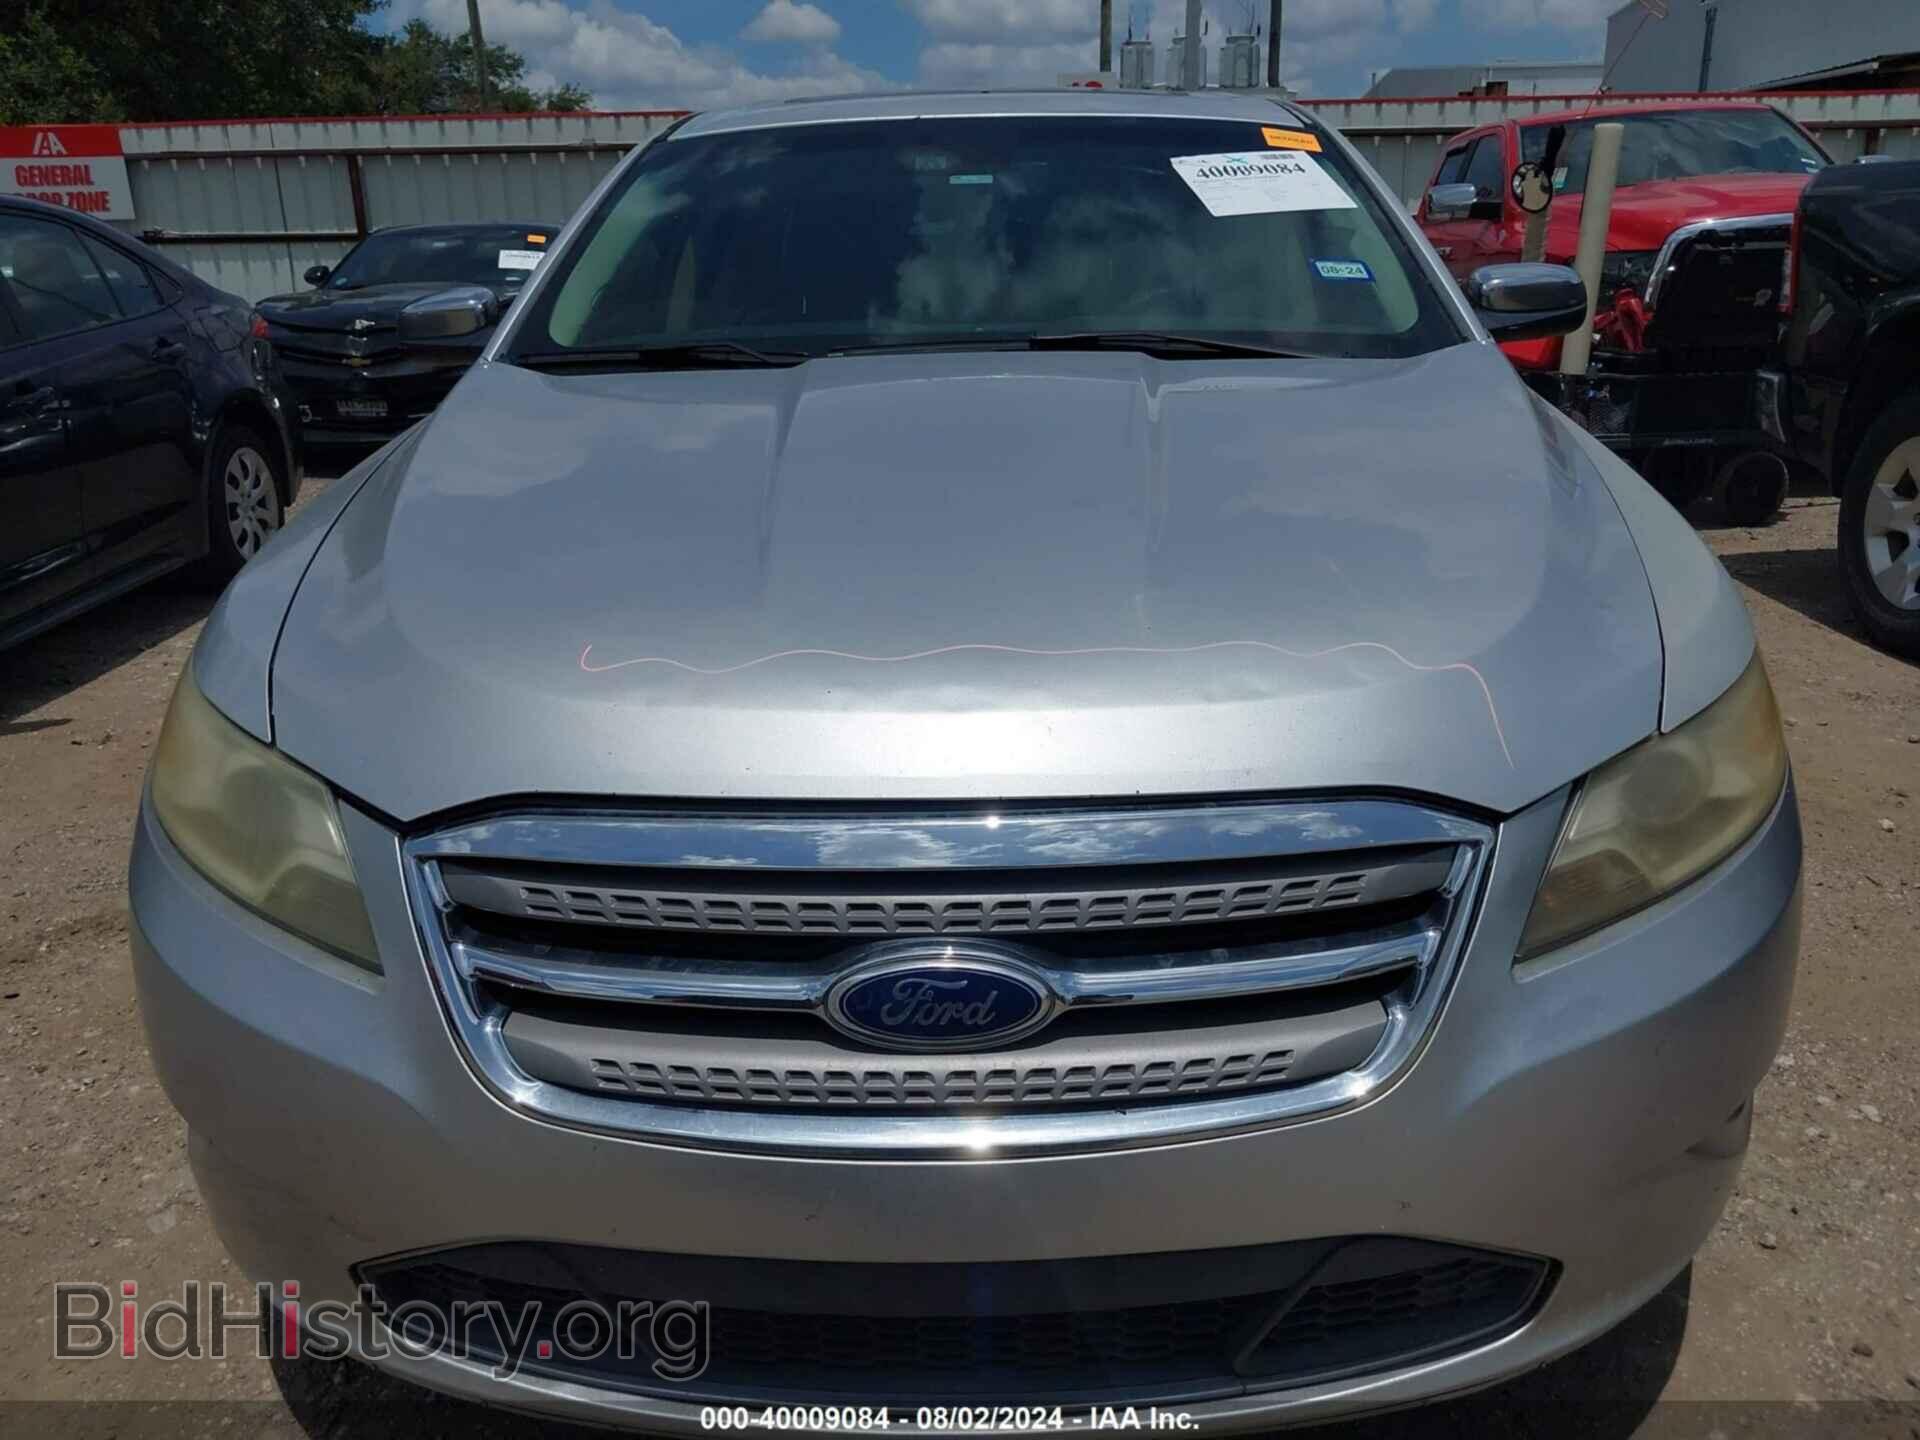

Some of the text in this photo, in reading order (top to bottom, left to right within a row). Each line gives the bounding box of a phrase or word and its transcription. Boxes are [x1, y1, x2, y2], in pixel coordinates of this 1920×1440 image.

[14, 163, 95, 187] GENERAL
[1196, 162, 1306, 179] 40009084
[65, 190, 112, 213] ZONE
[880, 977, 996, 1025] Ford
